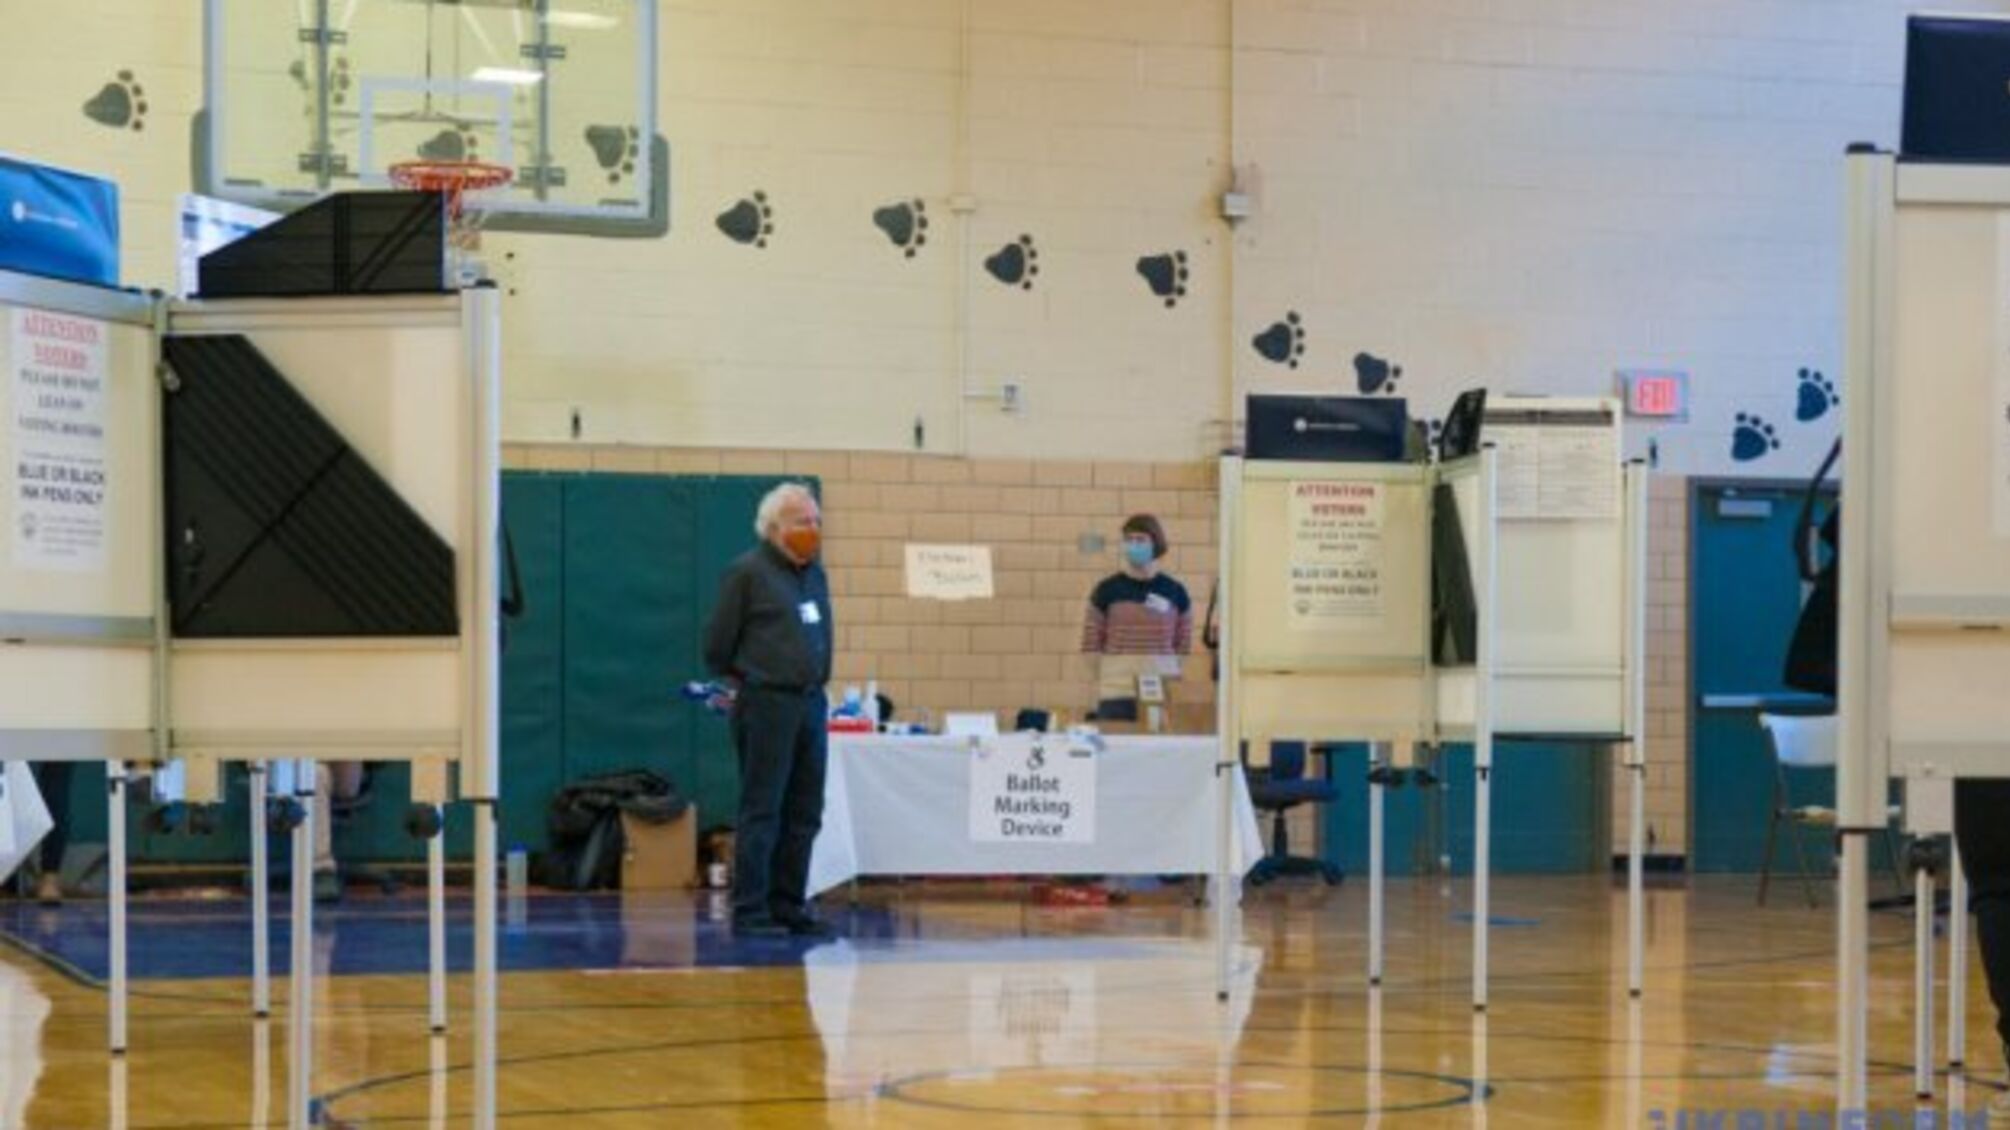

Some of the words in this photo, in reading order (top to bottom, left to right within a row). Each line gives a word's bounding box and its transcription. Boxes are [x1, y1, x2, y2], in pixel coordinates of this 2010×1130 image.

[1638, 380, 1675, 410] EXIT
[18, 460, 46, 480] BLUE
[50, 464, 68, 482] OR
[69, 467, 105, 487] BLACK
[20, 484, 39, 500] INK
[43, 486, 71, 503] PENS
[73, 489, 104, 507] ONLY
[1296, 484, 1374, 498] ATTENTION
[1311, 503, 1366, 516] VOTERS
[1292, 567, 1320, 580] BLUE
[1322, 567, 1339, 580] OR
[1341, 567, 1378, 580] BLACK
[1293, 583, 1312, 595] INK
[1315, 583, 1345, 596] PENS
[1006, 773, 1060, 792] Ballot
[994, 796, 1071, 819] Marking
[1001, 818, 1064, 836] Device
